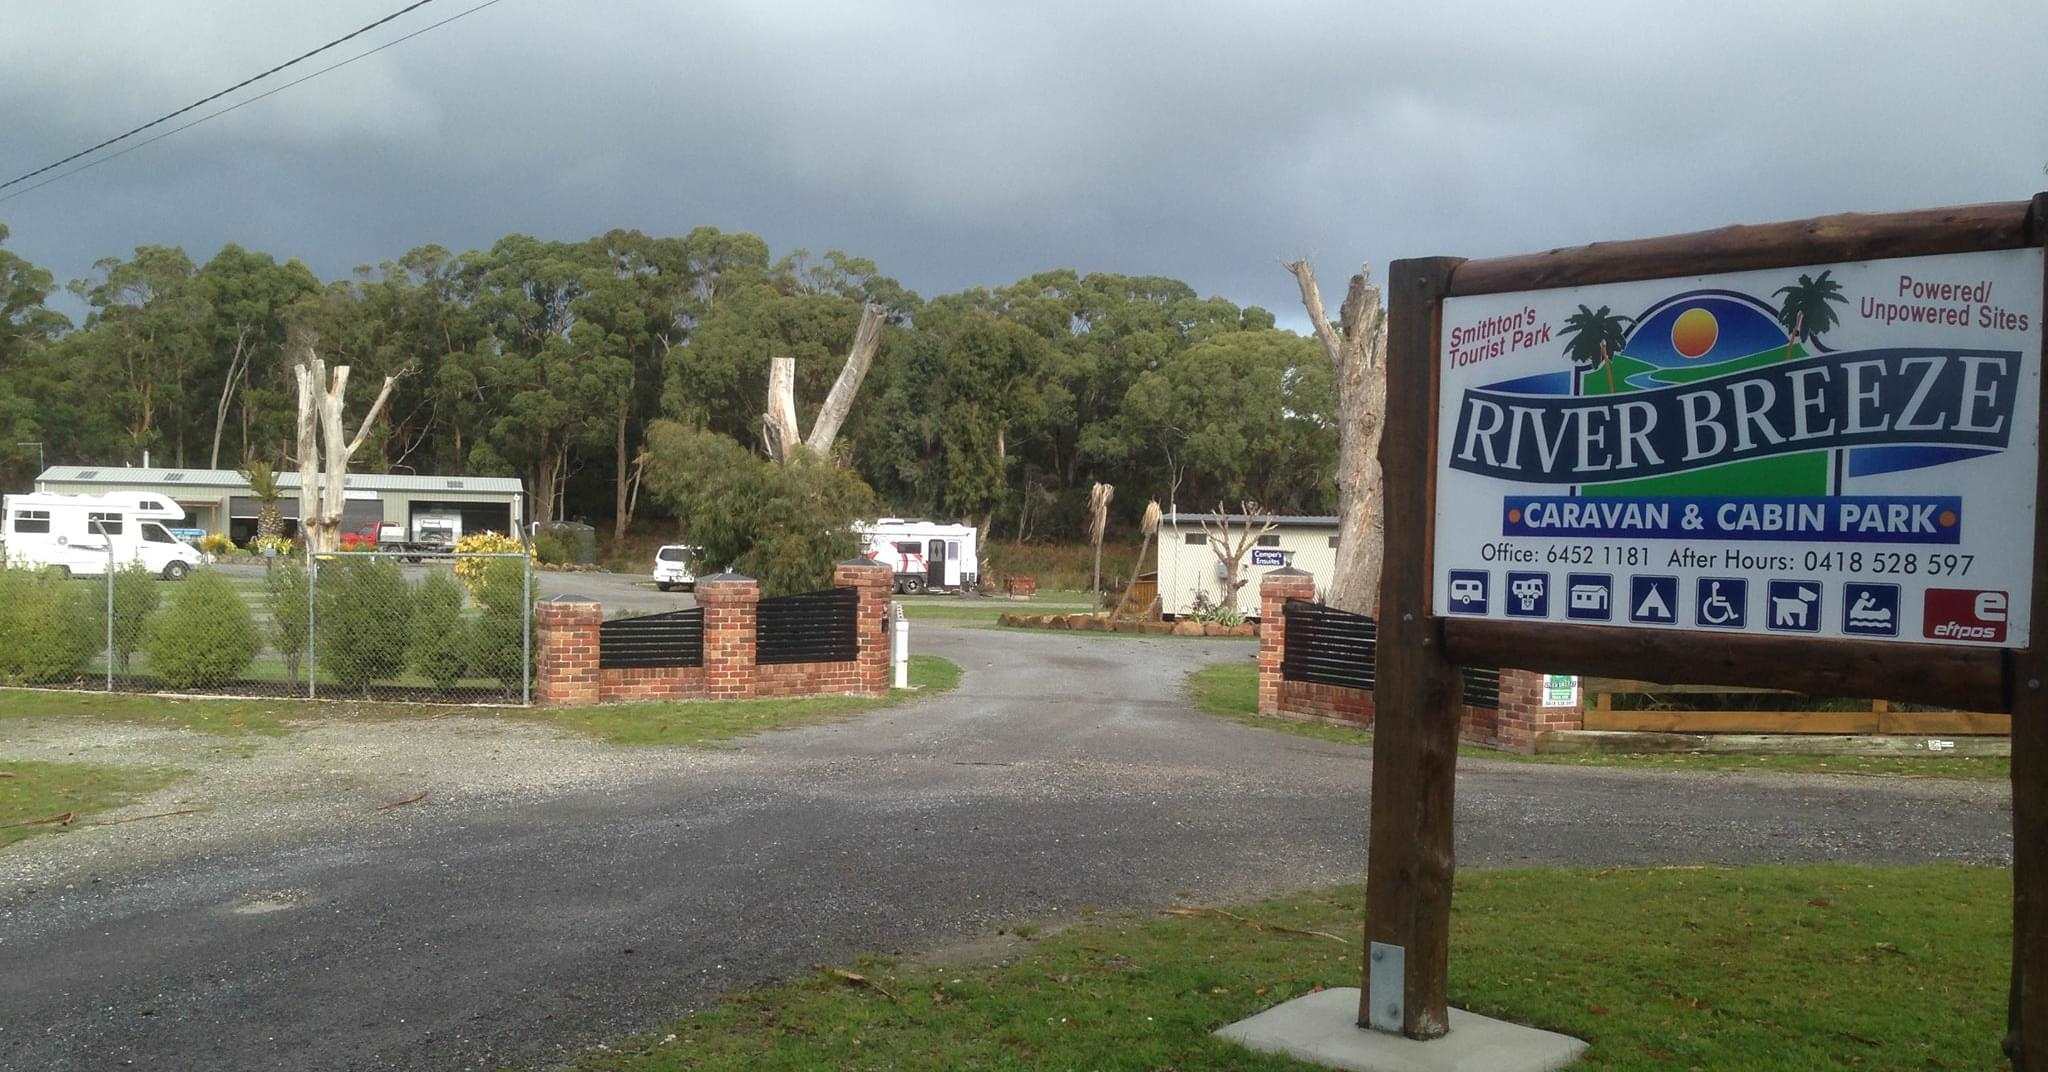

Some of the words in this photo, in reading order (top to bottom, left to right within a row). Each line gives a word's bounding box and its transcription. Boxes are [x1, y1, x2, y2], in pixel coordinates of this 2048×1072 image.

[1899, 275, 1992, 303] Powered/
[1450, 306, 1536, 348] Smithton's
[1861, 296, 1970, 327] Unpowered
[1978, 304, 2029, 332] Sites
[1449, 339, 1505, 370] Tourist
[1511, 324, 1551, 352] Park
[1457, 398, 1665, 474] RIVER
[1676, 355, 2008, 462] BREEZE
[1523, 502, 1669, 530] CARAVAN
[1680, 503, 1705, 531] &
[1716, 503, 1825, 533] CABIN
[1839, 504, 1938, 534] PARK
[1481, 542, 1538, 563] Office:
[1546, 544, 1594, 565] 6452
[1604, 545, 1649, 567] 1181
[1667, 549, 1718, 569] After
[1724, 549, 1795, 571] Hours:
[1804, 550, 1863, 572] 0418
[1871, 552, 1918, 574] 528
[1926, 554, 1975, 577] 597
[1933, 620, 1996, 639] eftpos
